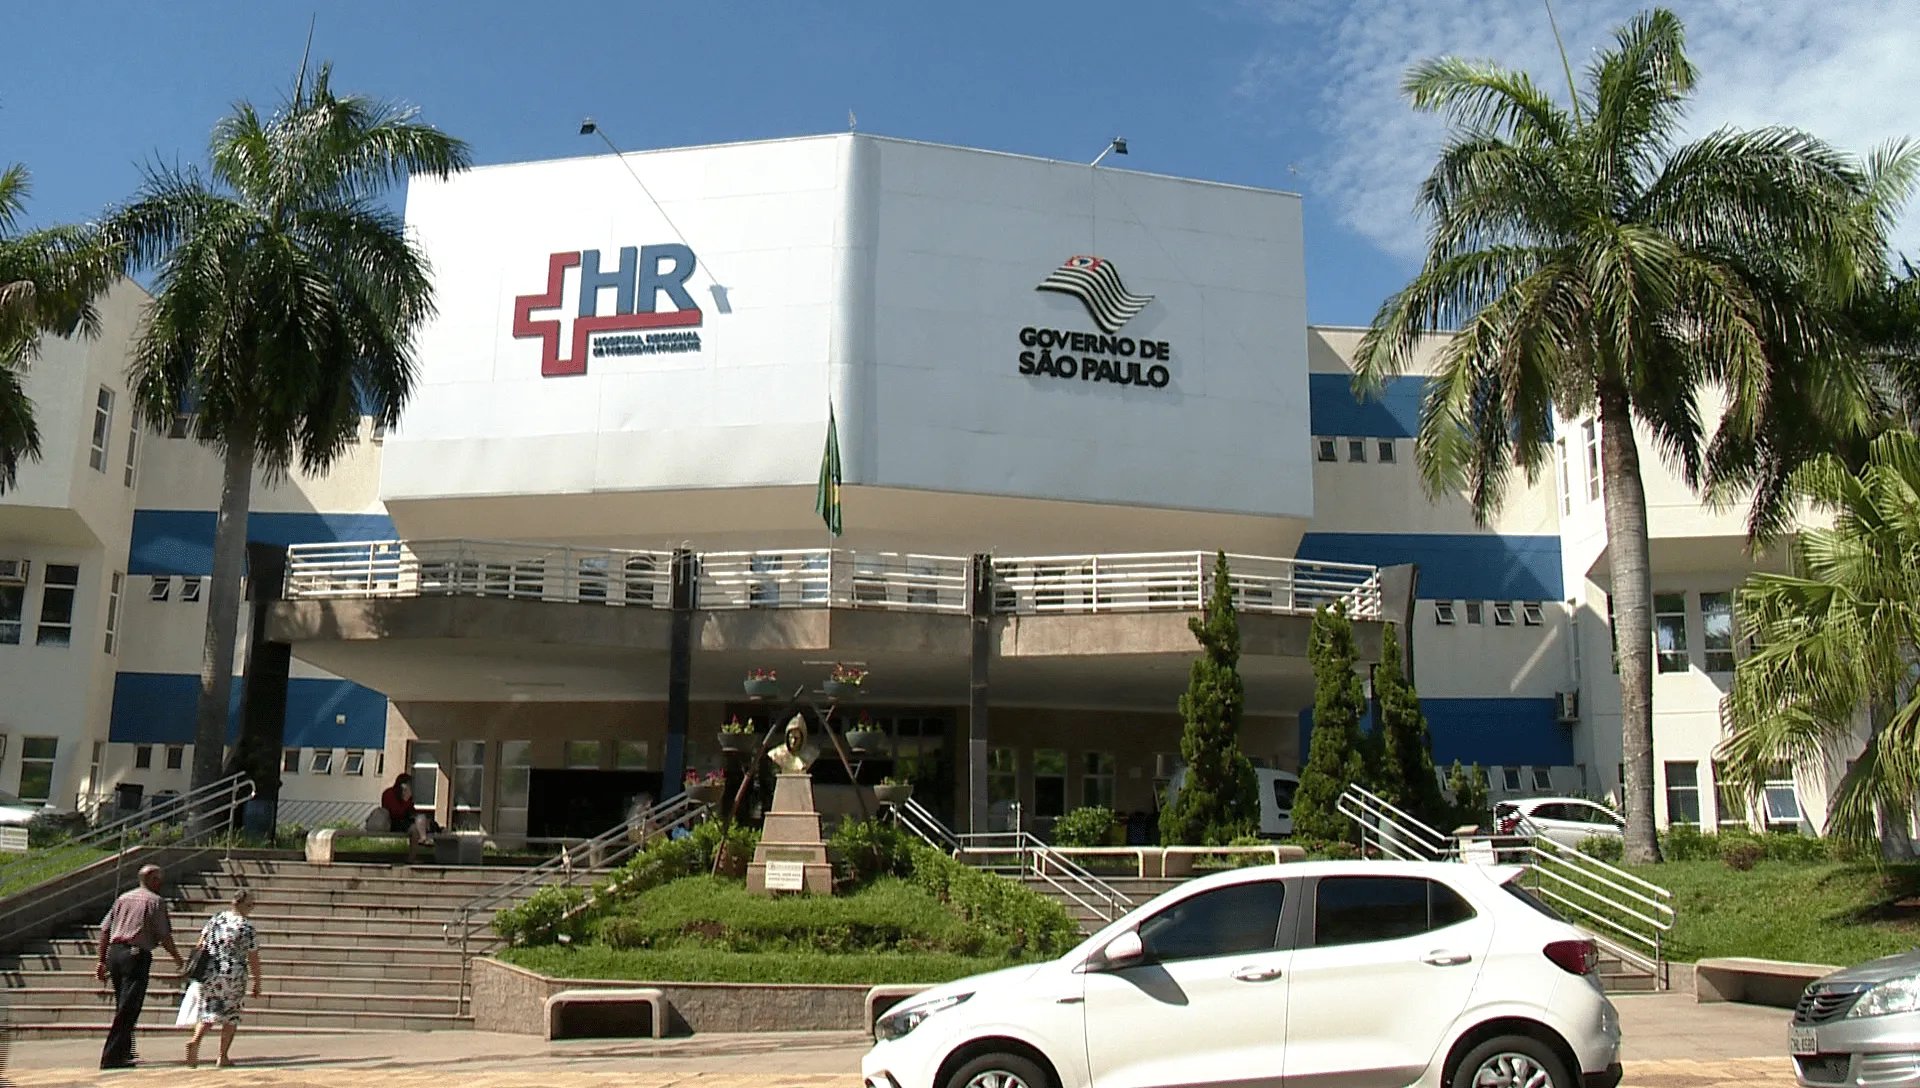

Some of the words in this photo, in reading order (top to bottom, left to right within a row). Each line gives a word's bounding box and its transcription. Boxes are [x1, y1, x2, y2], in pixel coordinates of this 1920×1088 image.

[579, 243, 700, 317] HR
[1019, 327, 1136, 356] GOVERNO
[1140, 339, 1170, 361] DE
[1019, 349, 1078, 379] SÃO
[1082, 357, 1170, 388] PAULO
